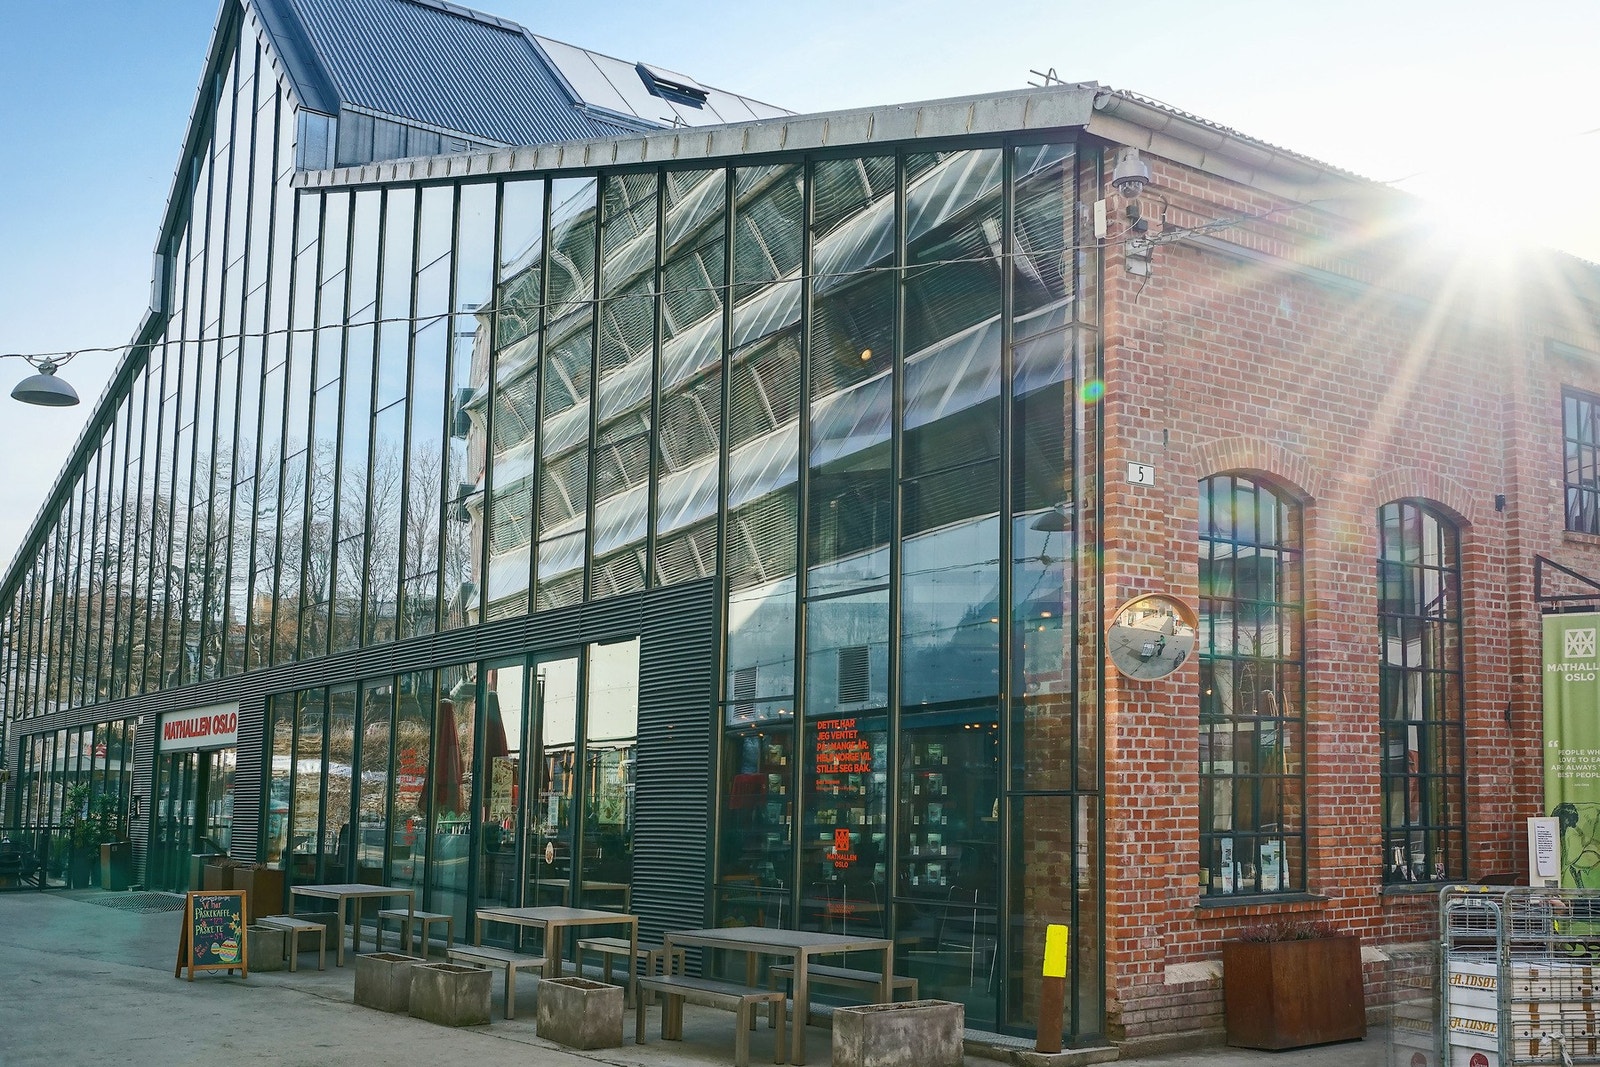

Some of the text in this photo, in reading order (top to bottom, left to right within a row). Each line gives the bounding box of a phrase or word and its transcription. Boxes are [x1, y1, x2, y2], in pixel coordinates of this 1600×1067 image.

[1138, 466, 1144, 482] 5
[1565, 672, 1595, 681] OSLO
[164, 712, 237, 740] MATHALLEN OSLO
[817, 719, 839, 729] DETTE
[817, 730, 858, 740] JEG VENTET
[831, 741, 856, 750] MANGE
[835, 752, 859, 761] NORGE
[816, 763, 871, 773] STILLE SEG BAK.
